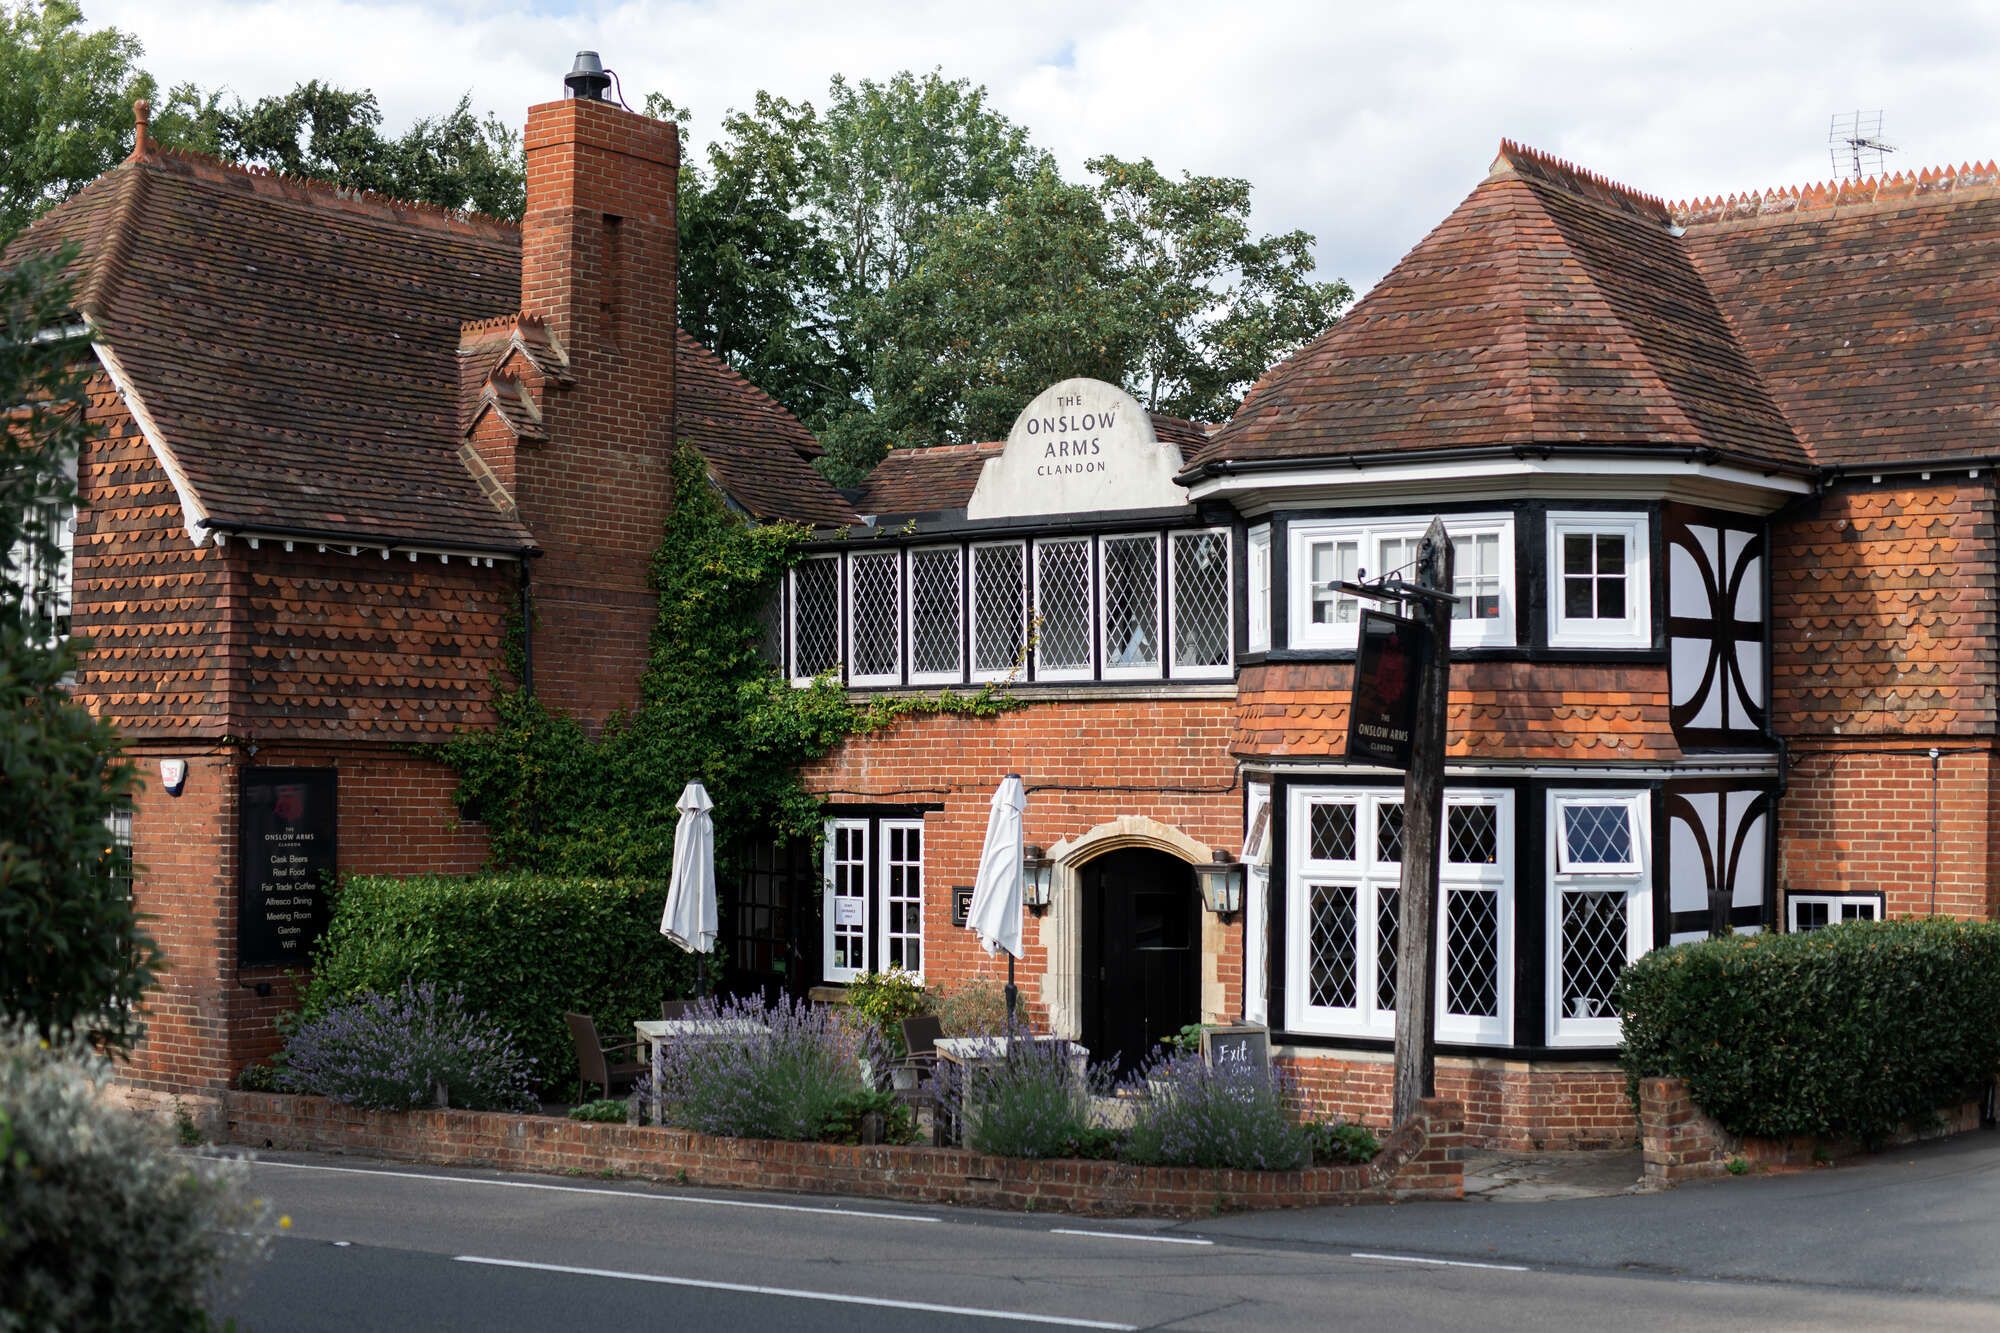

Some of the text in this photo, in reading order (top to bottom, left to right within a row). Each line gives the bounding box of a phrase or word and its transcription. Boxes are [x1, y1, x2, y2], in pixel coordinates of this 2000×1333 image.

[1057, 395, 1082, 407] THE
[1027, 412, 1115, 435] ONSLOW
[1044, 438, 1100, 458] ARMS
[1037, 461, 1105, 476] CLANDON
[1359, 723, 1408, 742] ONSLOW ARMS
[265, 833, 314, 841] ONSLOW ARMS
[271, 854, 309, 863] Cask Beers
[273, 867, 305, 876] Real Food
[262, 881, 316, 892] Fair Trade Coffee
[266, 896, 312, 907] Alfresco Dining
[267, 911, 312, 922] Meeting Room
[278, 925, 301, 934] Garden
[1218, 1039, 1247, 1064] Exit
